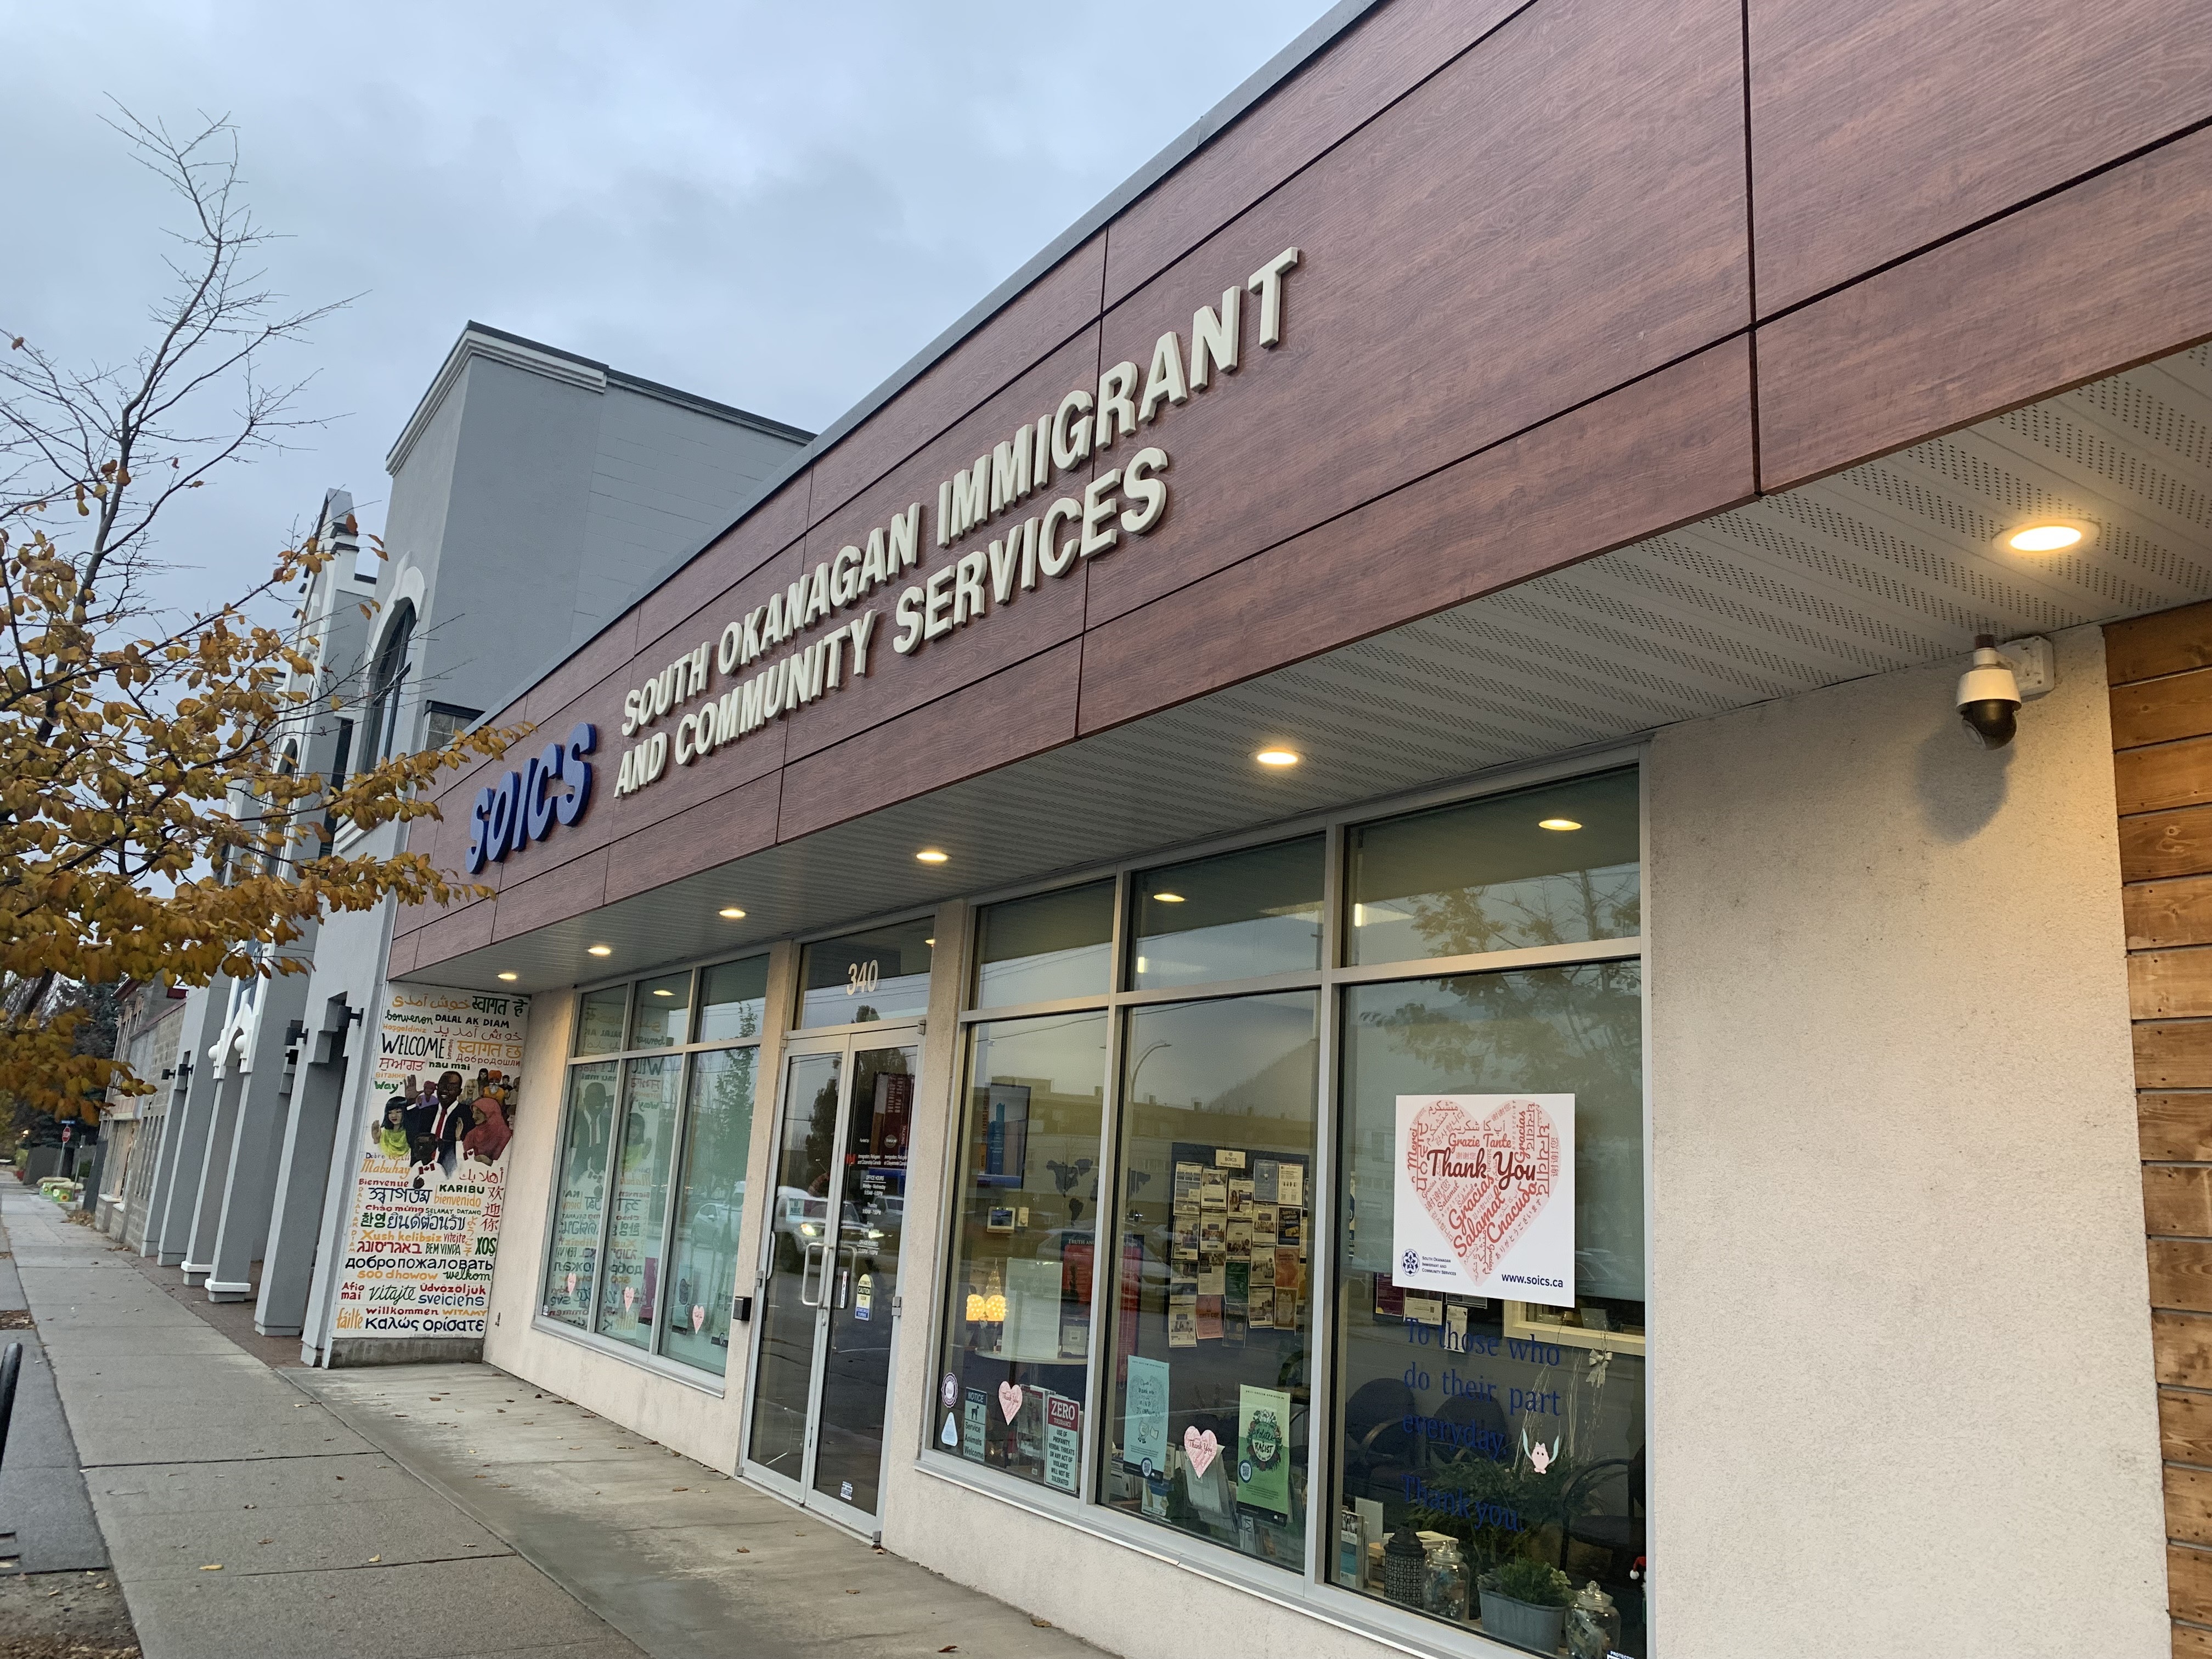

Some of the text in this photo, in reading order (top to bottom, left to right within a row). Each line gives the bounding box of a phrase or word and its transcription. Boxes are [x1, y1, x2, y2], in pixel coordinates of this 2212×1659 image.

[622, 246, 1299, 736] SOUTH OKANAGAN IMMIGRANT
[614, 447, 1169, 798] AND COMMUNITY SERVICES
[465, 723, 597, 875] SOICS
[846, 960, 878, 995] 340
[471, 995, 511, 1015] स्वागत
[435, 1014, 509, 1029] DALAL AK DIAM
[382, 1032, 446, 1059] WELCOME
[456, 1040, 503, 1057] स्वागत
[451, 1062, 470, 1070] mai
[1448, 1133, 1511, 1154] Grazie Tante
[1514, 1110, 1531, 1164] Gracias
[1407, 1127, 1417, 1170] Merci
[360, 1158, 410, 1179] Mabuhay
[1426, 1147, 1536, 1190] Thank You
[359, 1178, 409, 1187] Bienvenue
[439, 1184, 485, 1194] KARIBU
[434, 1185, 481, 1207] bienvenido
[1438, 1180, 1459, 1211] Salamat
[1449, 1174, 1494, 1235] Gracias
[1454, 1185, 1505, 1257] Salamat
[360, 1230, 442, 1242] Xush kelibsiz
[425, 1243, 461, 1255] BEM VINDA
[357, 1269, 438, 1280] soo dhowow
[443, 1268, 491, 1281] welkom
[1502, 1273, 1564, 1288] www.soics.ca
[342, 1282, 364, 1291] Afio
[418, 1293, 484, 1307] sveiciens
[366, 1306, 439, 1316] willkommen
[1405, 1317, 1561, 1366] To those who
[968, 1391, 984, 1403] NOTICE
[1403, 1362, 1561, 1416] do their part
[1051, 1400, 1075, 1421] ZERO
[965, 1421, 981, 1433] Service
[1053, 1418, 1071, 1427] TOLERANCE
[964, 1434, 982, 1446] Animals
[1189, 1439, 1212, 1454] Thank You
[1255, 1442, 1273, 1453] RACIST
[964, 1446, 984, 1459] Welcome
[1048, 1443, 1075, 1455] VERBAL THREATS
[1401, 1474, 1525, 1533] Thank you.
